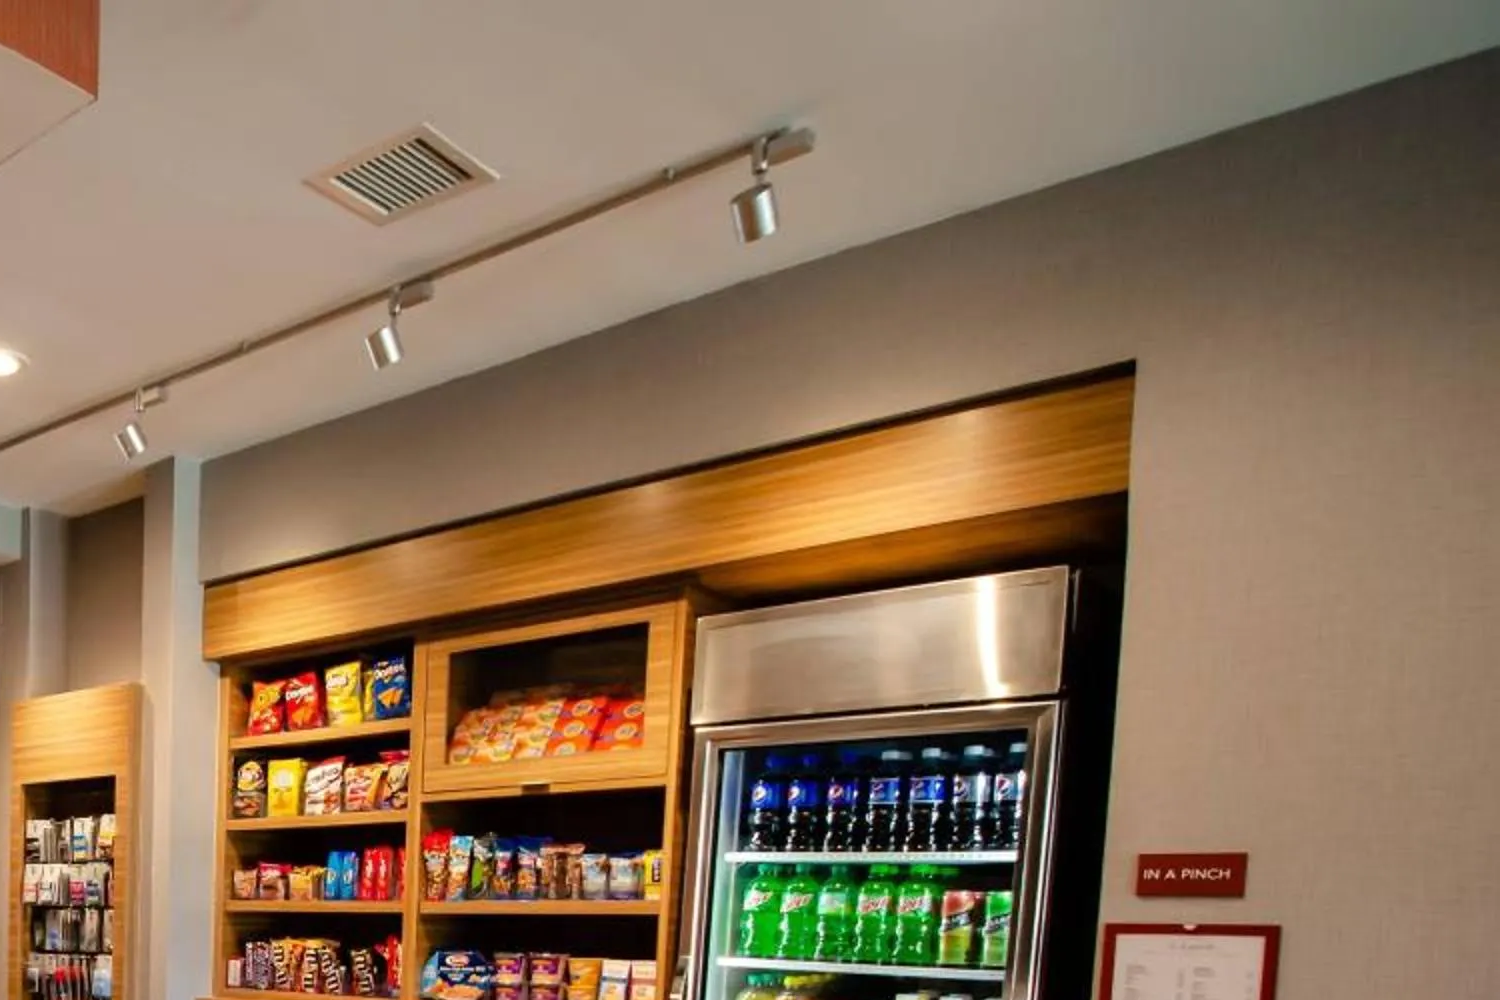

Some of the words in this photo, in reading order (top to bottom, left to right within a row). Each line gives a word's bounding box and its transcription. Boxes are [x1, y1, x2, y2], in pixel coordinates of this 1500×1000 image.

[1143, 869, 1160, 880] IN
[1164, 869, 1176, 880] A
[1181, 868, 1231, 880] PINCH
